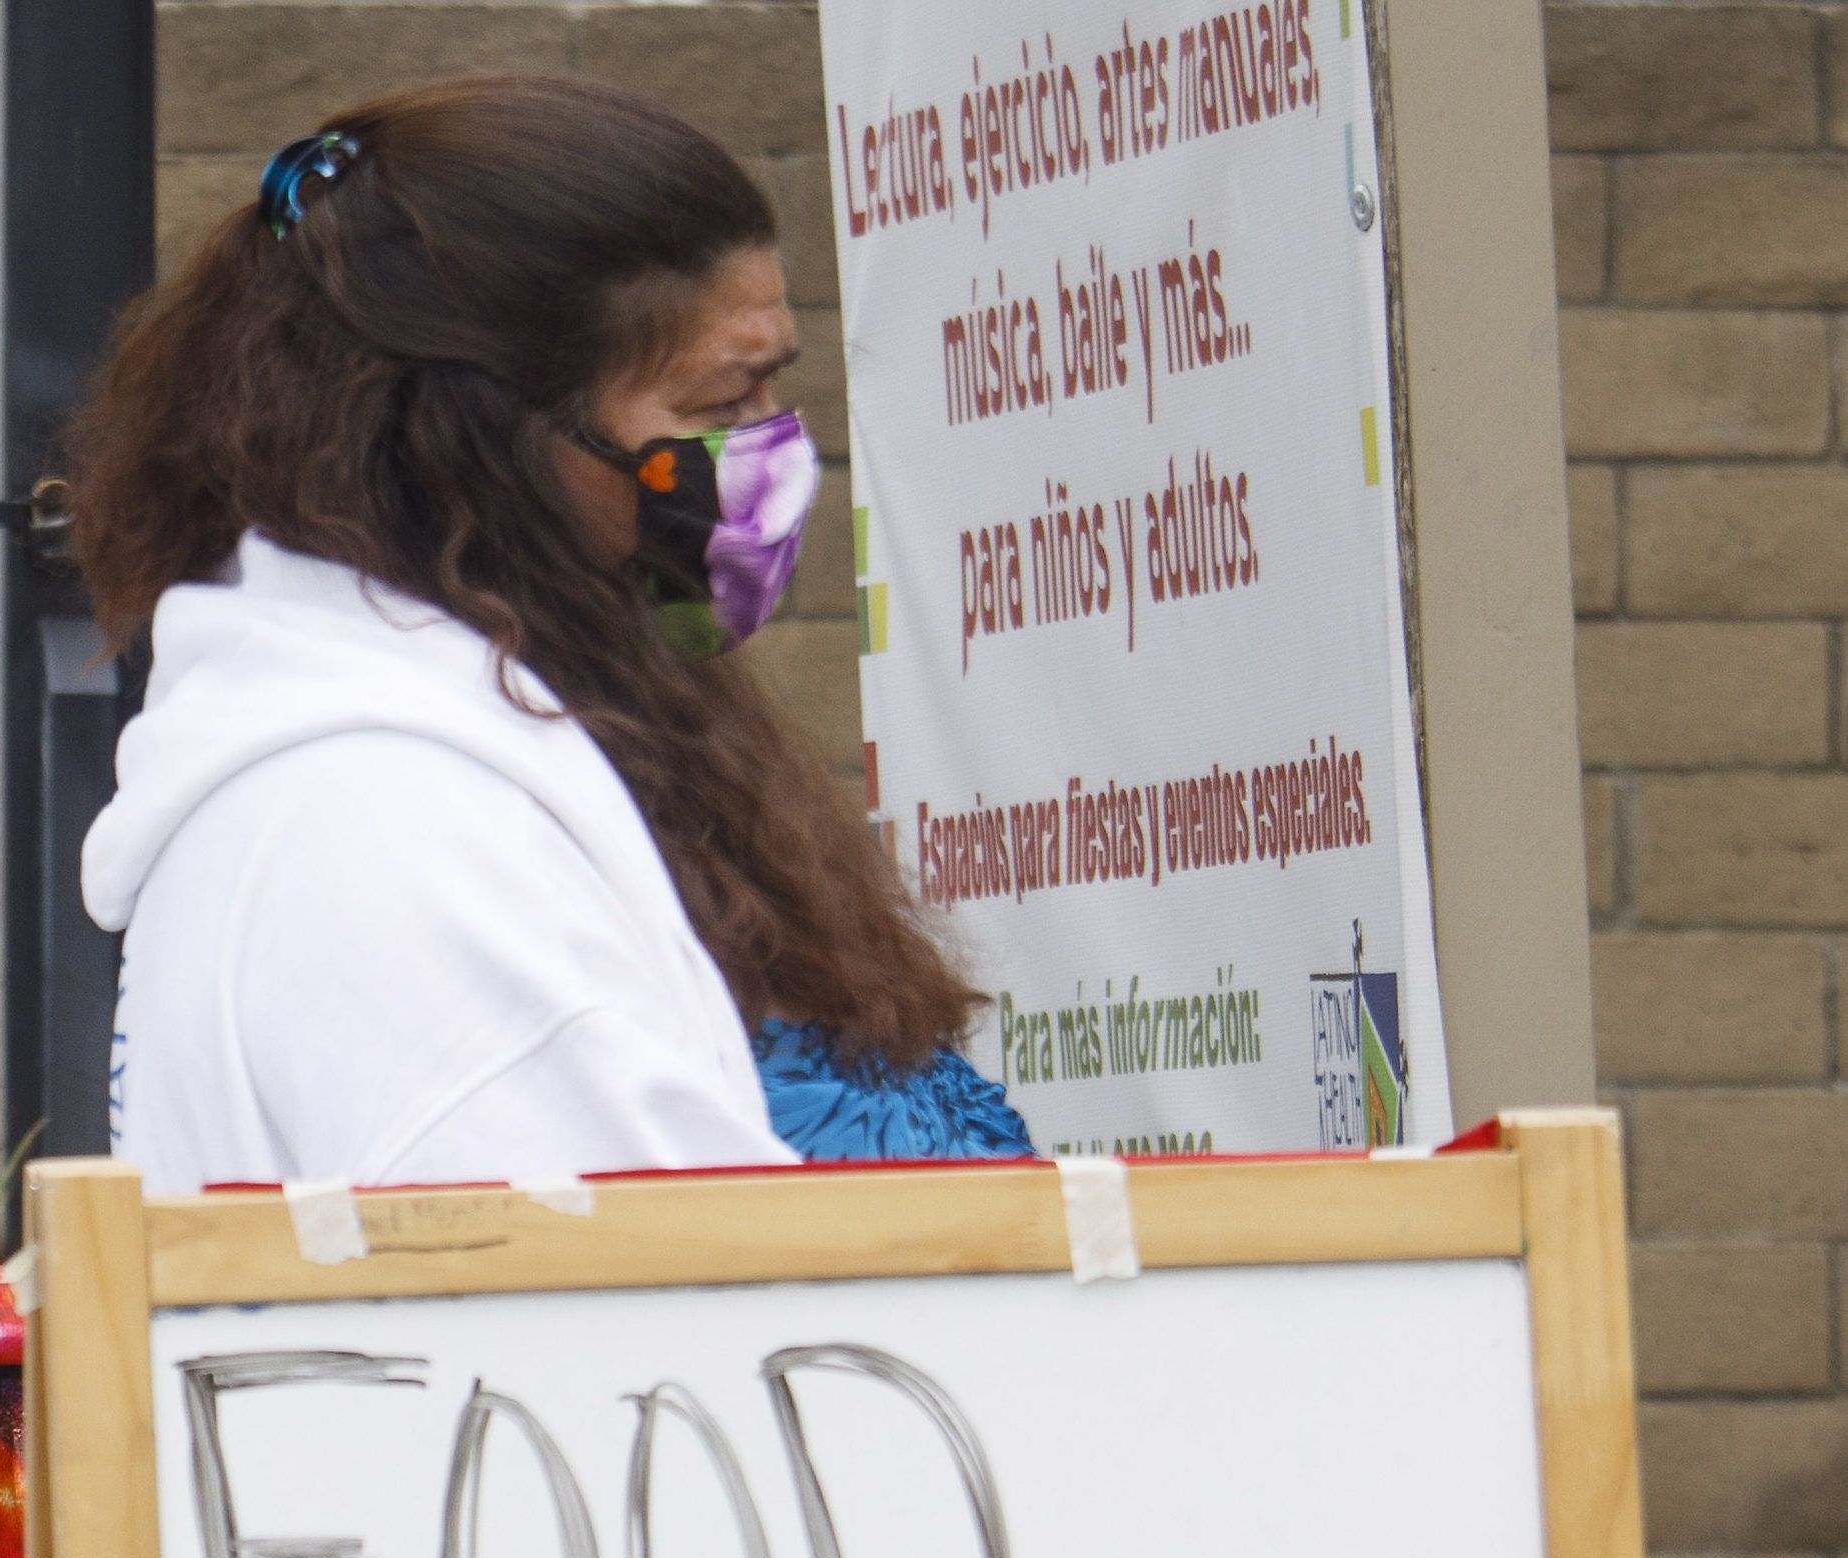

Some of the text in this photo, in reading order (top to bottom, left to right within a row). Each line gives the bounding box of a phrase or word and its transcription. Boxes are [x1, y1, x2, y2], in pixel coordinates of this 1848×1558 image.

[838, 0, 1320, 243] Lectura, ejercicio, artes manuales,
[941, 218, 1251, 426] música, baile y más...
[960, 445, 1259, 681] para niños y adultos.
[917, 734, 1372, 913] Espacios para fiestas y eventos especiales.
[999, 963, 1262, 1086] Para más información:
